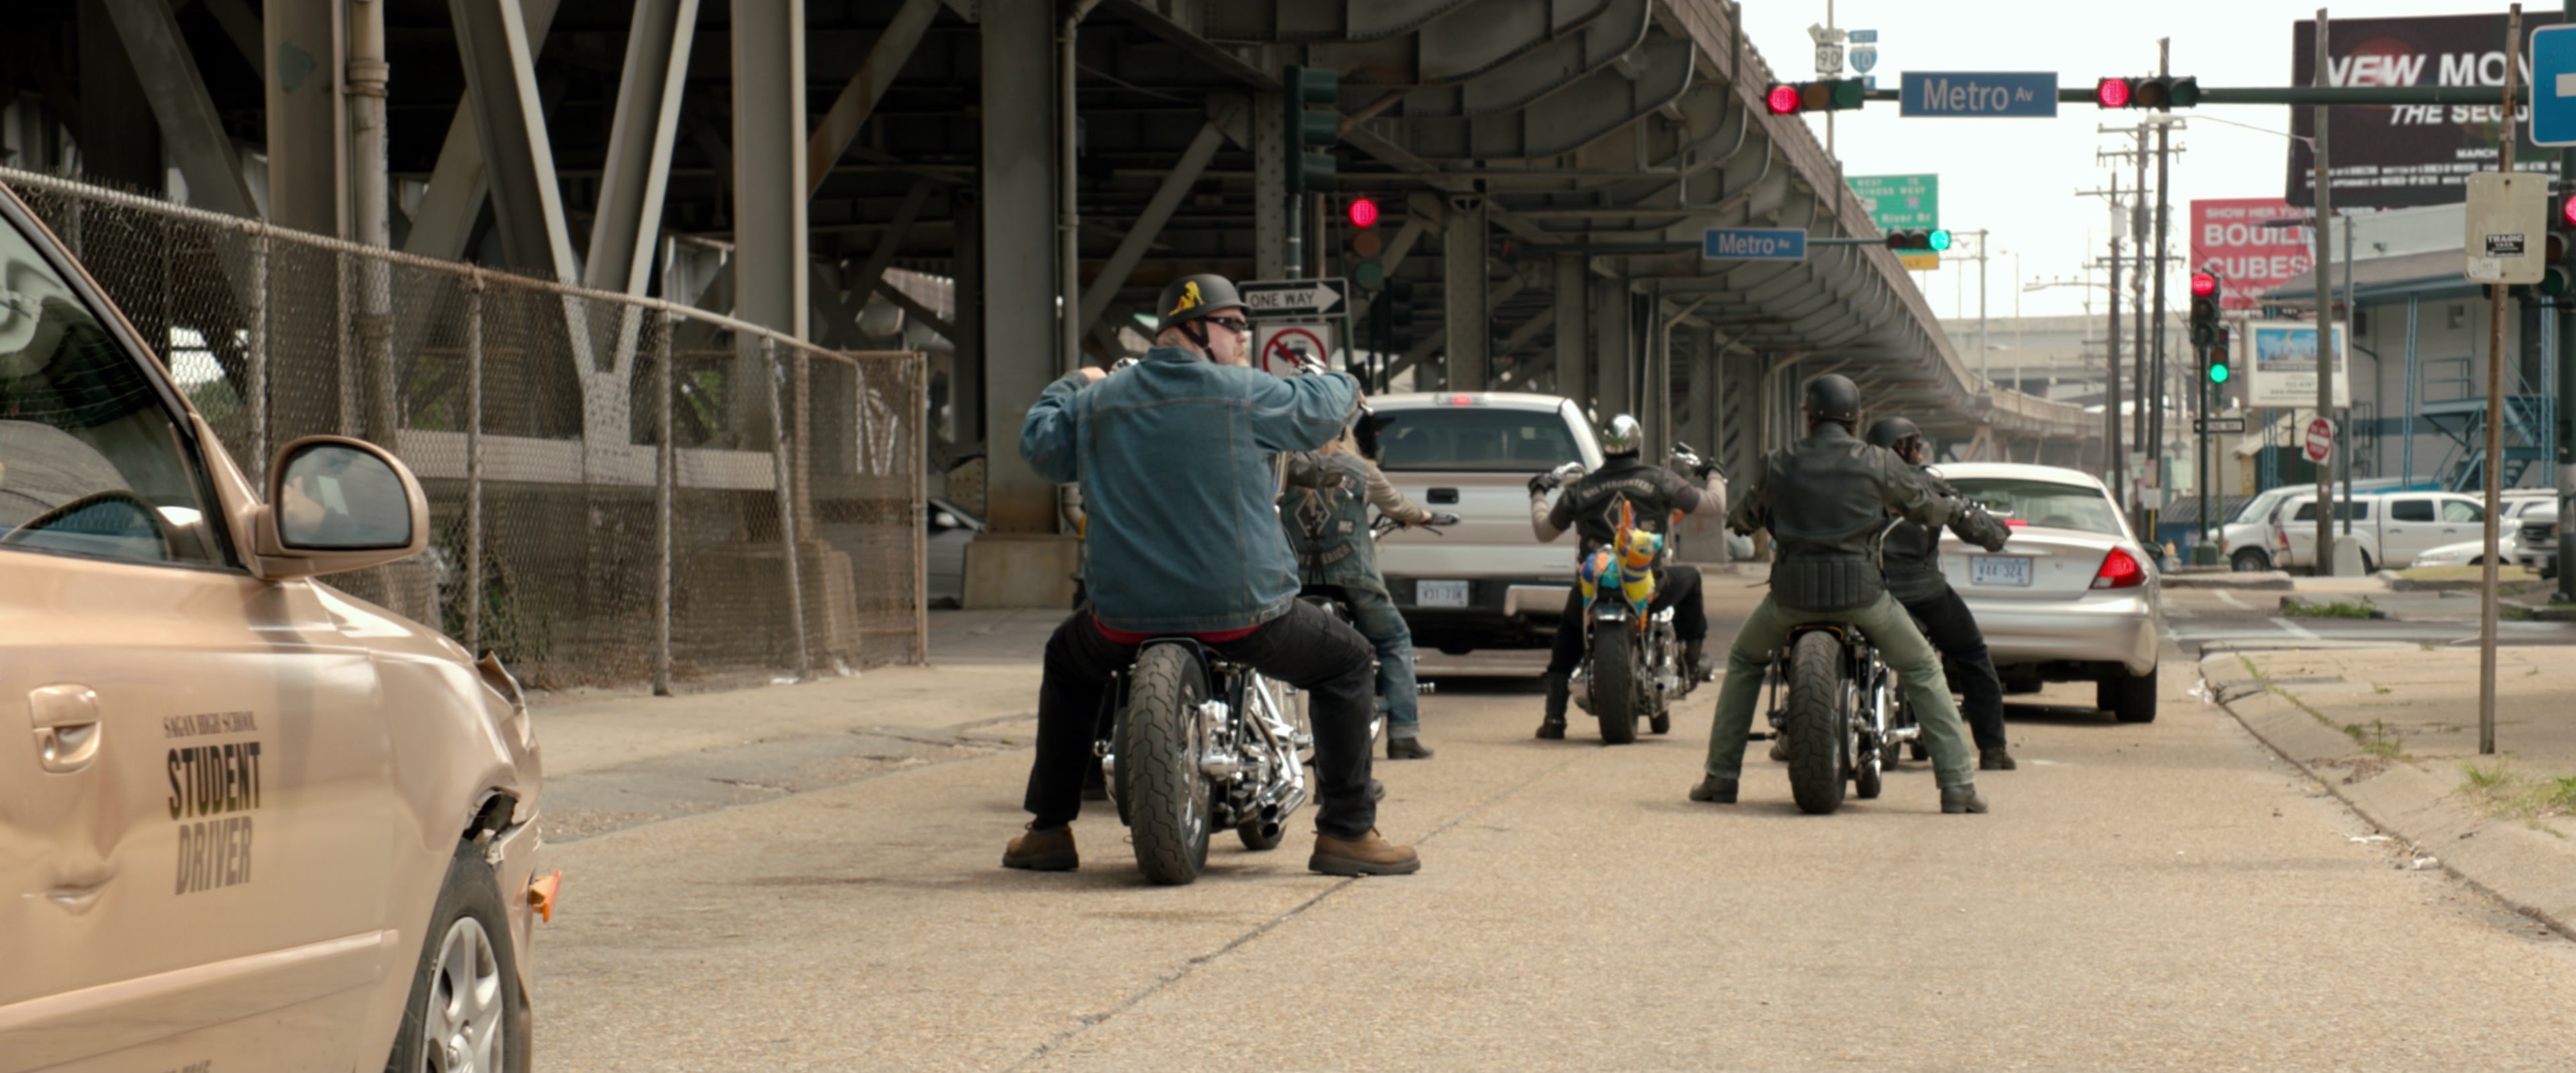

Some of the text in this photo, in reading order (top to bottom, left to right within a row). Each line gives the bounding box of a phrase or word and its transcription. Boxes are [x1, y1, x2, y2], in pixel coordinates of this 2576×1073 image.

[1819, 51, 1839, 67] 90
[1854, 52, 1872, 69] 10
[1923, 78, 2034, 112] Metro Av
[2390, 104, 2444, 125] THE
[1718, 233, 1775, 255] Metro
[1250, 291, 1315, 308] ONE WAY
[197, 713, 222, 736] HIGH
[221, 711, 258, 734] SCHOOL
[168, 741, 260, 821] STUDENT
[175, 815, 253, 896] DRIVER
